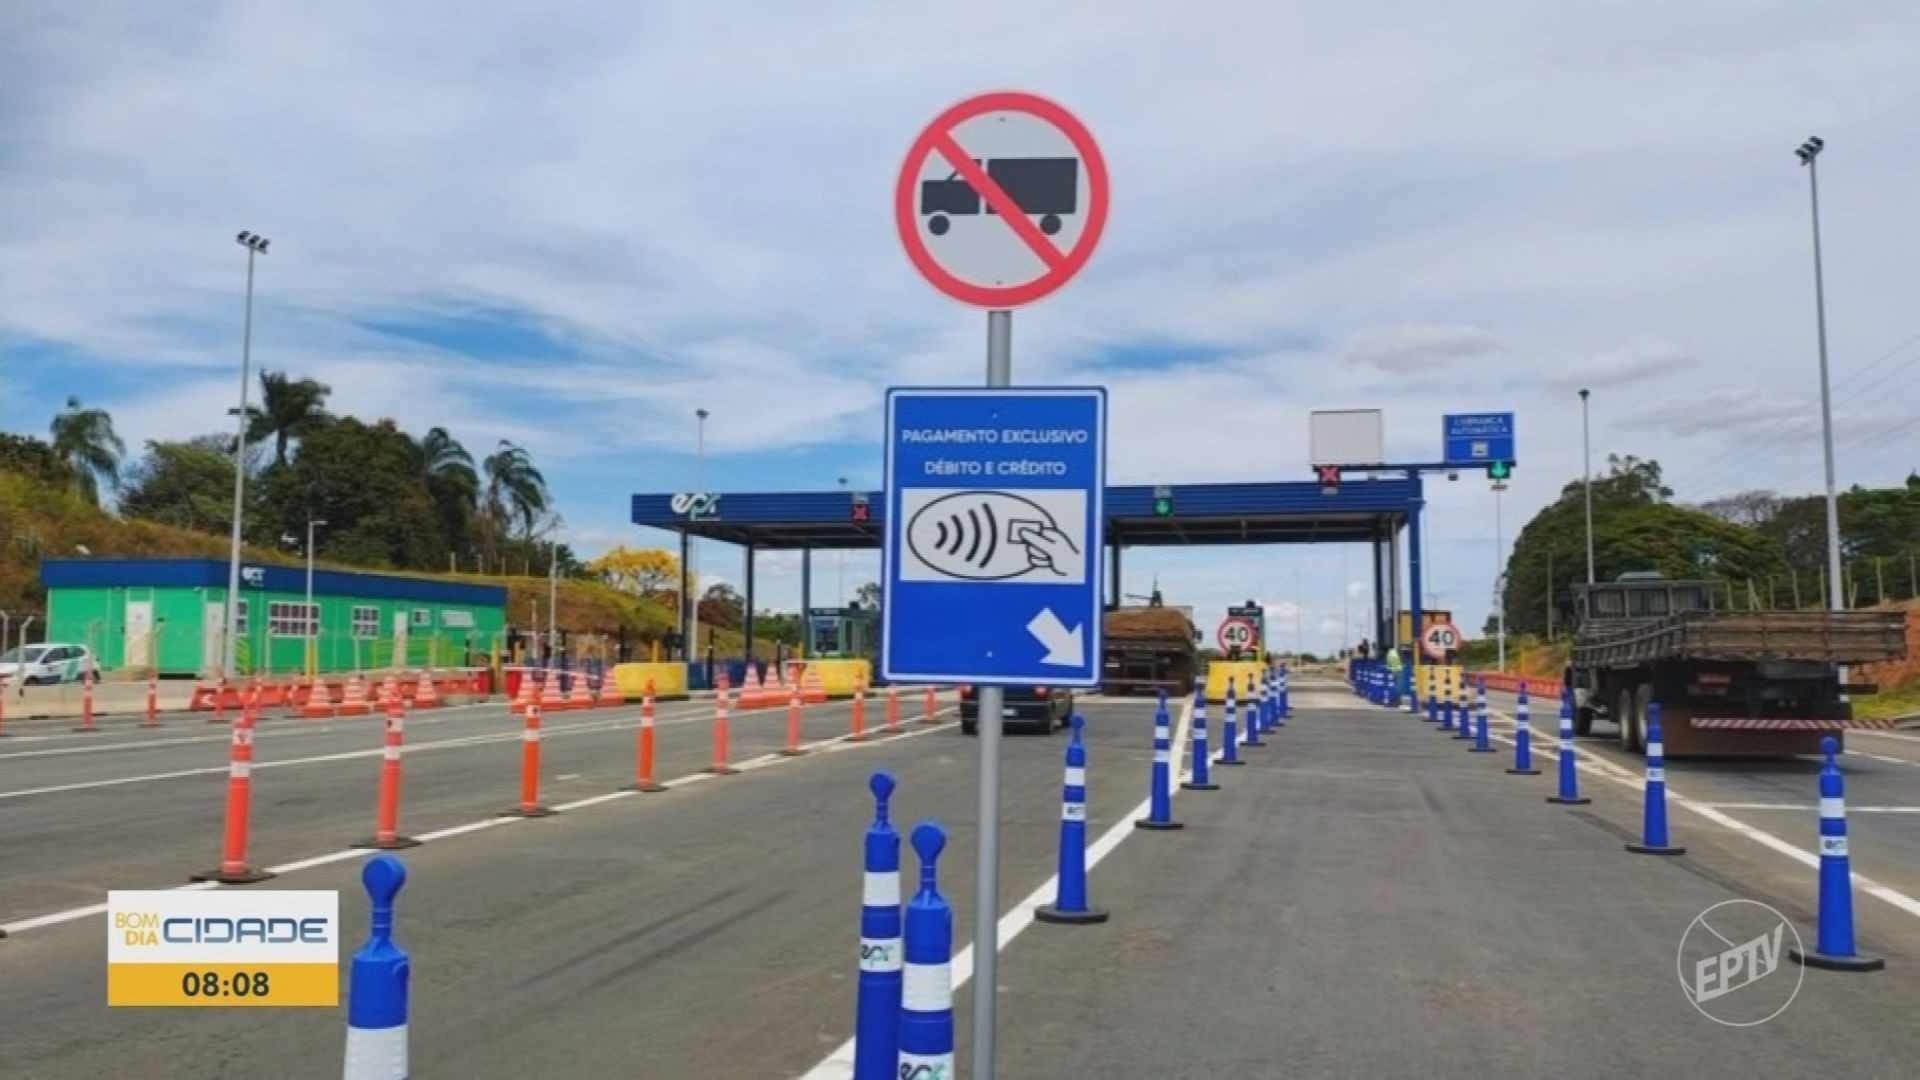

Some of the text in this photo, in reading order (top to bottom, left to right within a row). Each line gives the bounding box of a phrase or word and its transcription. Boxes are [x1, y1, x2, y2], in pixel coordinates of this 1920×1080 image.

[902, 429, 1088, 443] PAGAMENTO EXCLUSIVO
[925, 458, 1067, 475] DÉBITO E CRÉDITO
[1224, 626, 1249, 642] 40
[1428, 627, 1454, 645] 40
